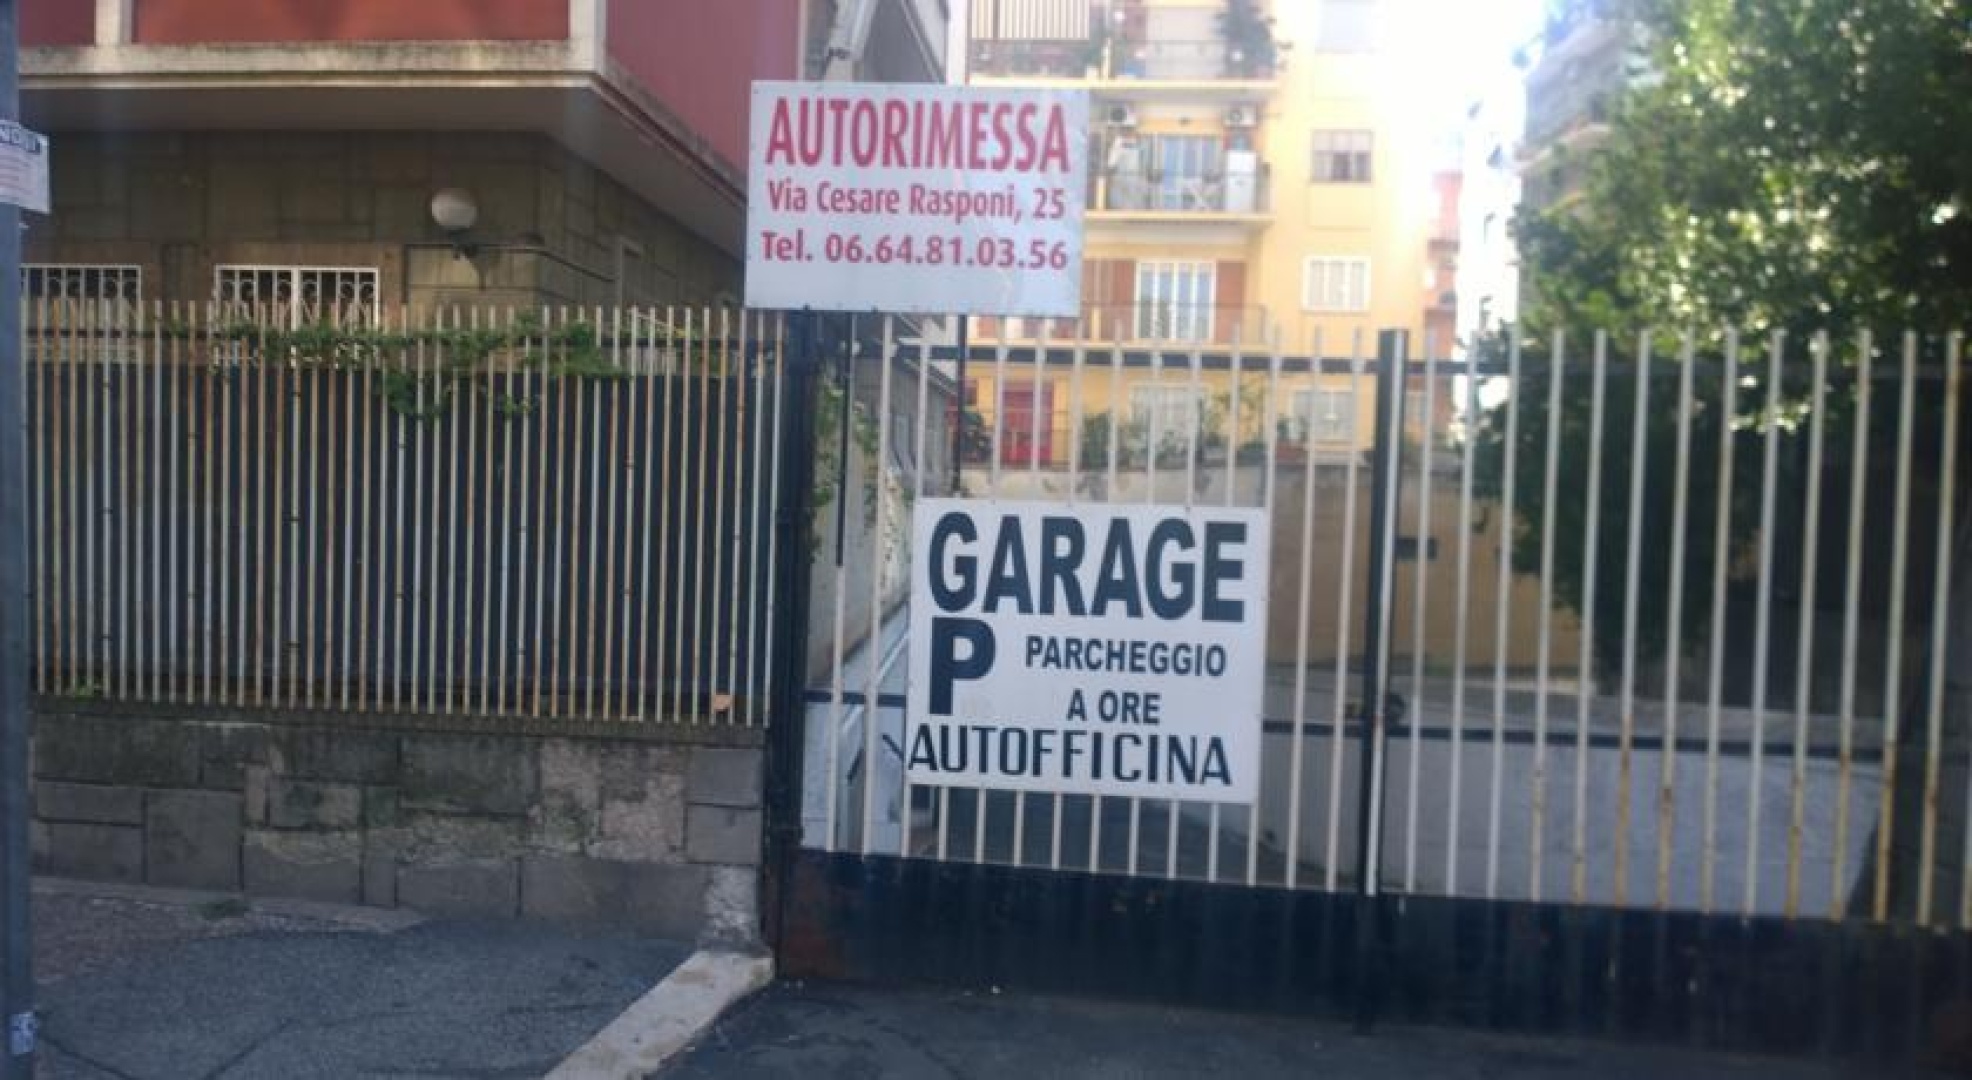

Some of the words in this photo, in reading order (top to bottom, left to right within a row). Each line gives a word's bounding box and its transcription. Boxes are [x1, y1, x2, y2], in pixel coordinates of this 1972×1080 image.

[765, 97, 1070, 173] AUTORIMESSA
[768, 179, 807, 213] Via
[816, 181, 900, 214] Cesare
[909, 184, 1022, 225] Rasponi,
[1032, 188, 1065, 219] 25
[761, 229, 813, 261] Tel.
[825, 233, 1068, 270] 06.64.81.03.56
[929, 511, 1247, 622] GARAGE
[929, 616, 996, 716] P
[1025, 635, 1227, 676] PARCHEGGIO
[1066, 689, 1087, 721] A
[1098, 691, 1161, 724] ORE
[908, 723, 1232, 785] AUTOFFICINA
